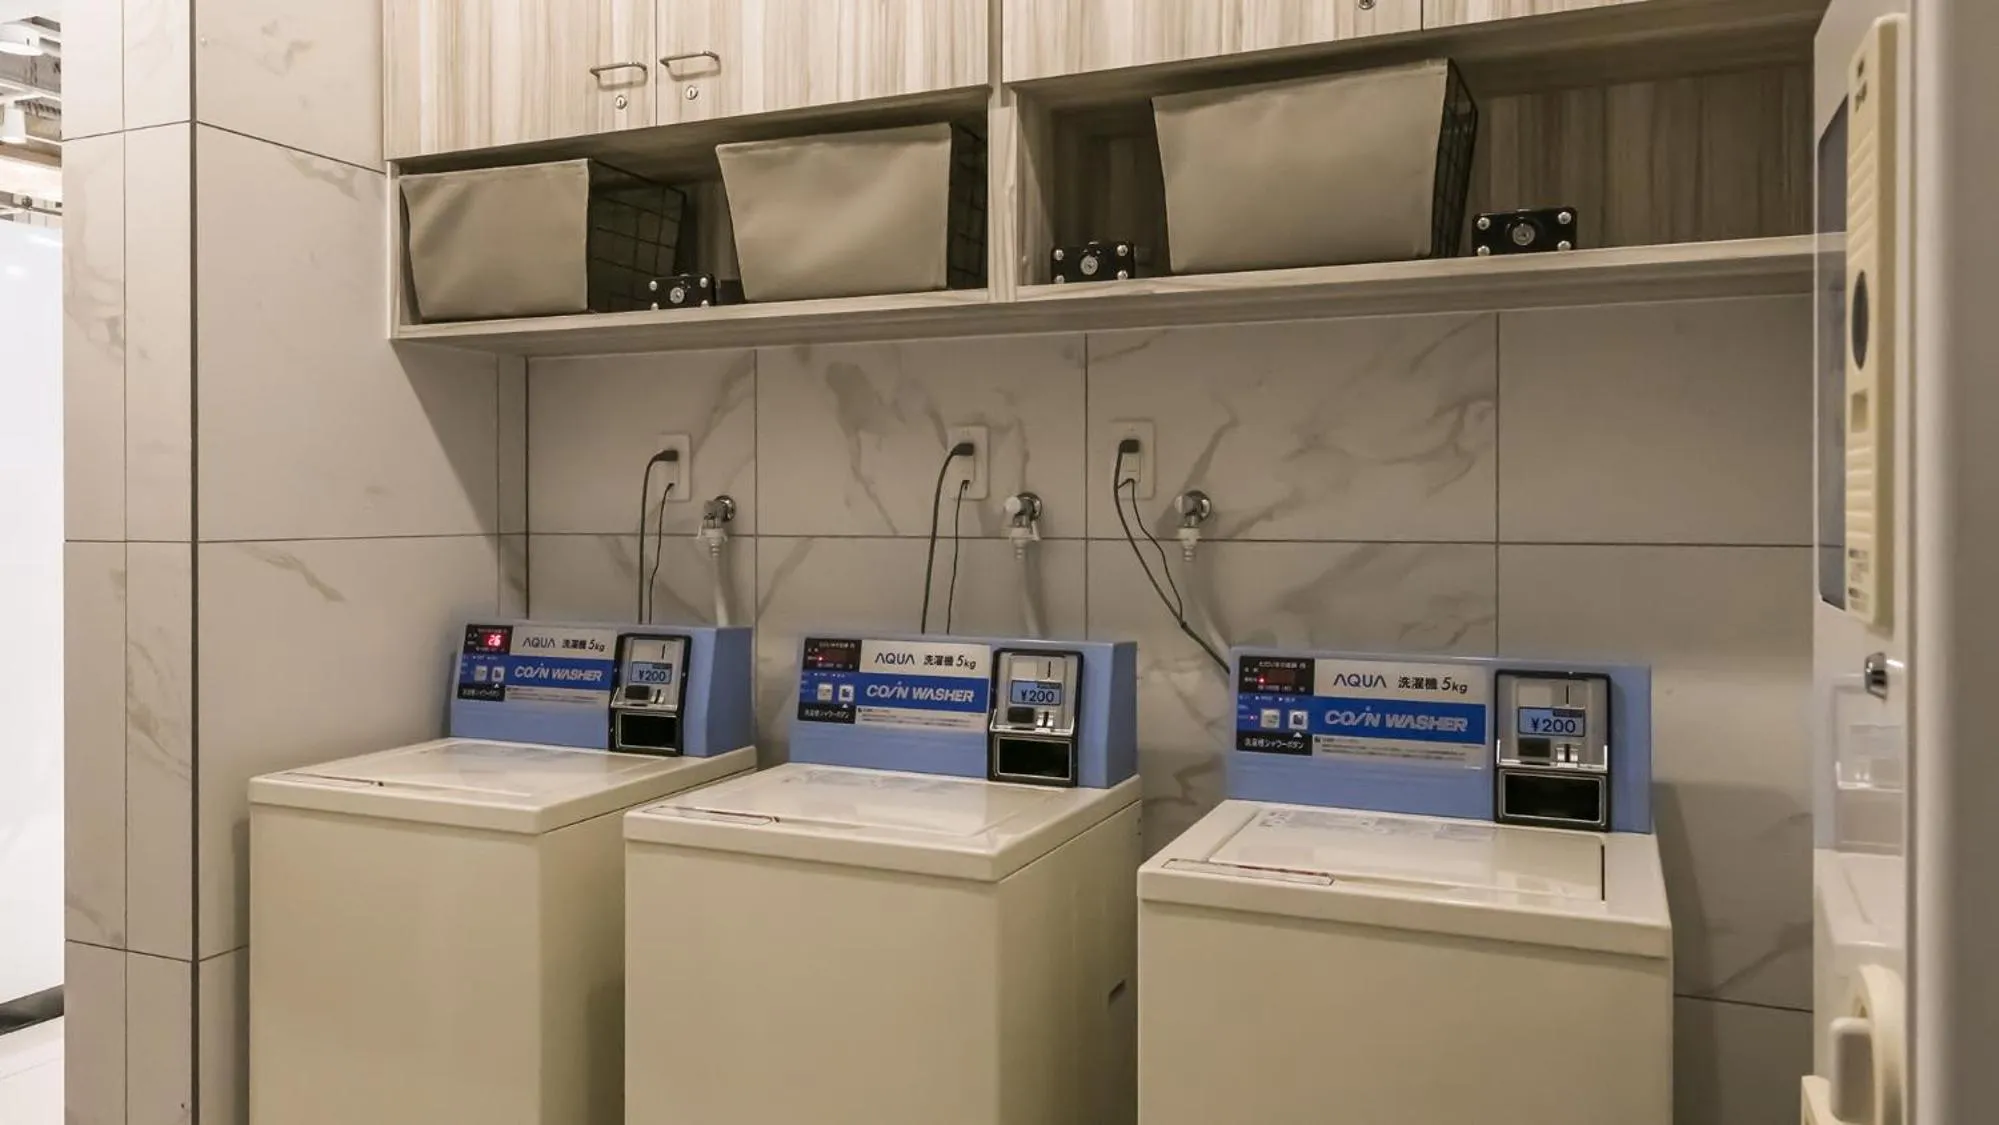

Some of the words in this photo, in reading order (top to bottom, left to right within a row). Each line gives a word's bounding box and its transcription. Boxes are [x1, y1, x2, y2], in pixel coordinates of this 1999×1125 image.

[488, 634, 502, 647] 26
[523, 637, 555, 648] AQUA
[588, 639, 605, 652] 5kg
[875, 652, 915, 665] AQUA
[924, 655, 953, 666] 洗濯機
[955, 655, 976, 669] 5kg
[551, 668, 602, 682] WASHER
[639, 670, 666, 682] ¥200
[1333, 673, 1387, 688] AQUA
[1398, 676, 1438, 690] 洗濯機
[1441, 677, 1467, 693] 5kg
[912, 687, 974, 702] WASHER
[1021, 689, 1055, 702] ¥200
[1385, 714, 1468, 732] WASHER
[1529, 718, 1576, 733] ¥200
